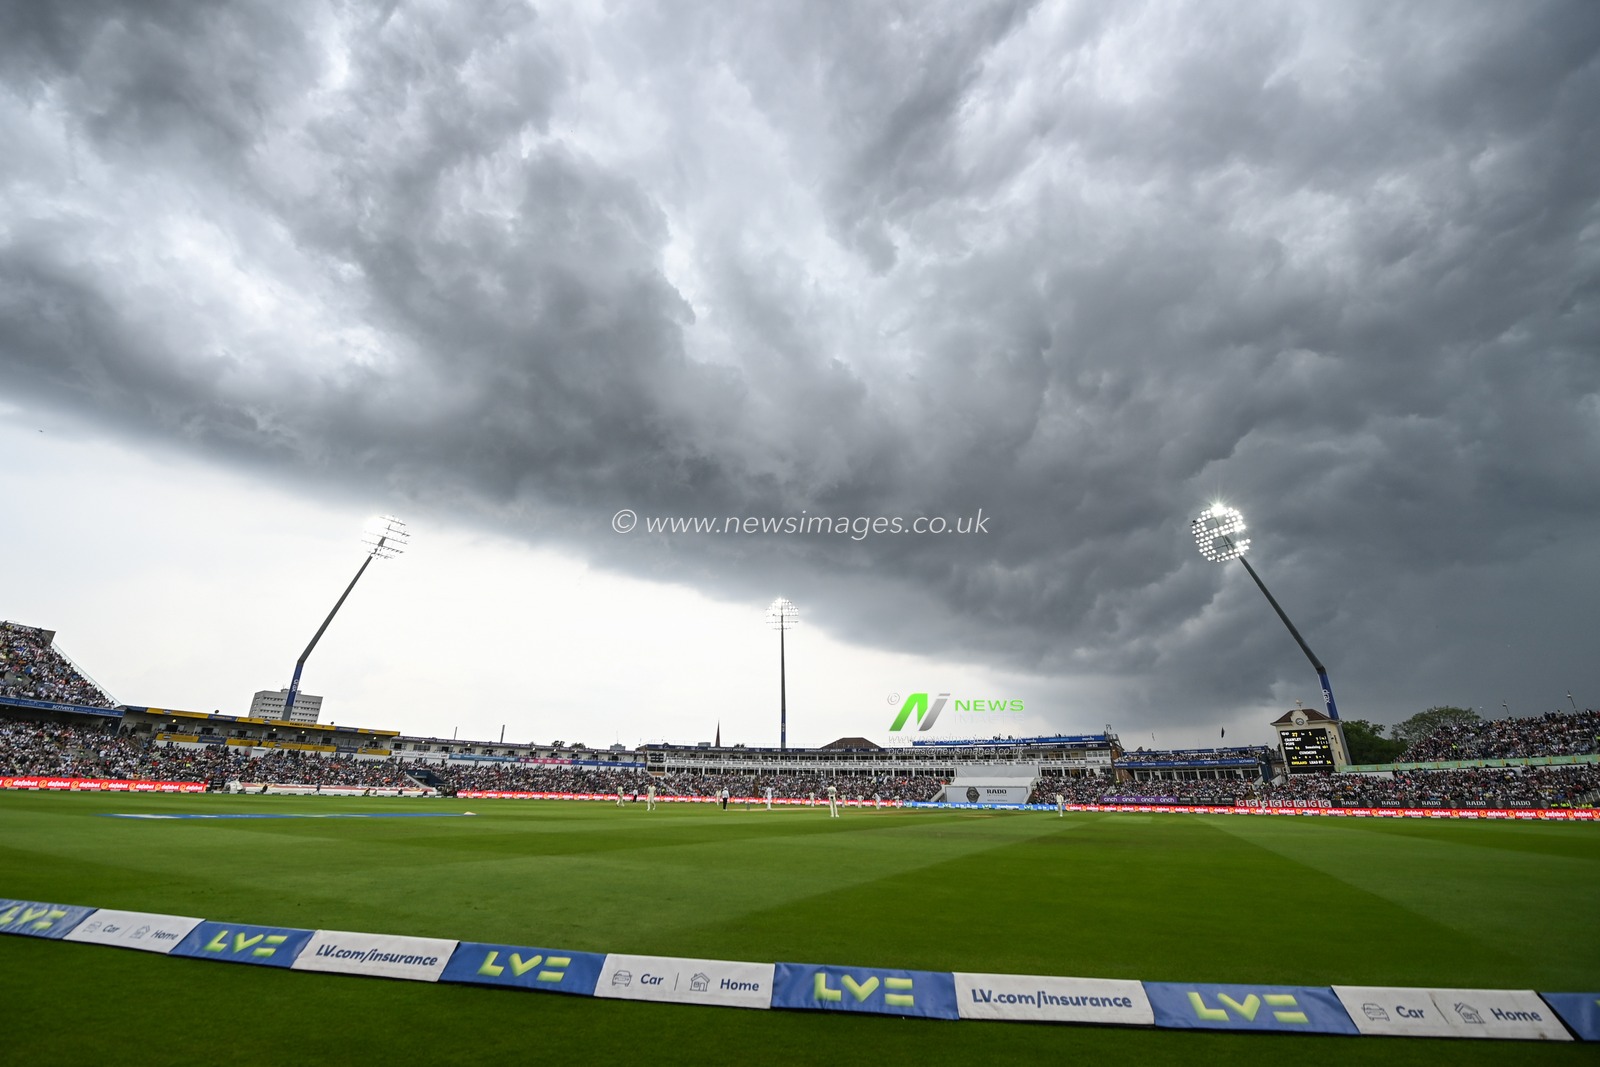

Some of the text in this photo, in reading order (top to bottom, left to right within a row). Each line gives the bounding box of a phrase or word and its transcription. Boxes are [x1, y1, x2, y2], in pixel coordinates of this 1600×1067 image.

[13, 779, 38, 787] dafabet
[47, 780, 70, 788] dafabet
[102, 924, 179, 941] Car Home
[315, 944, 438, 966] LV.com/insurance
[640, 973, 759, 992] Car Home
[971, 988, 1132, 1010] LV.com/insurance
[1395, 1005, 1543, 1022] Car Home
